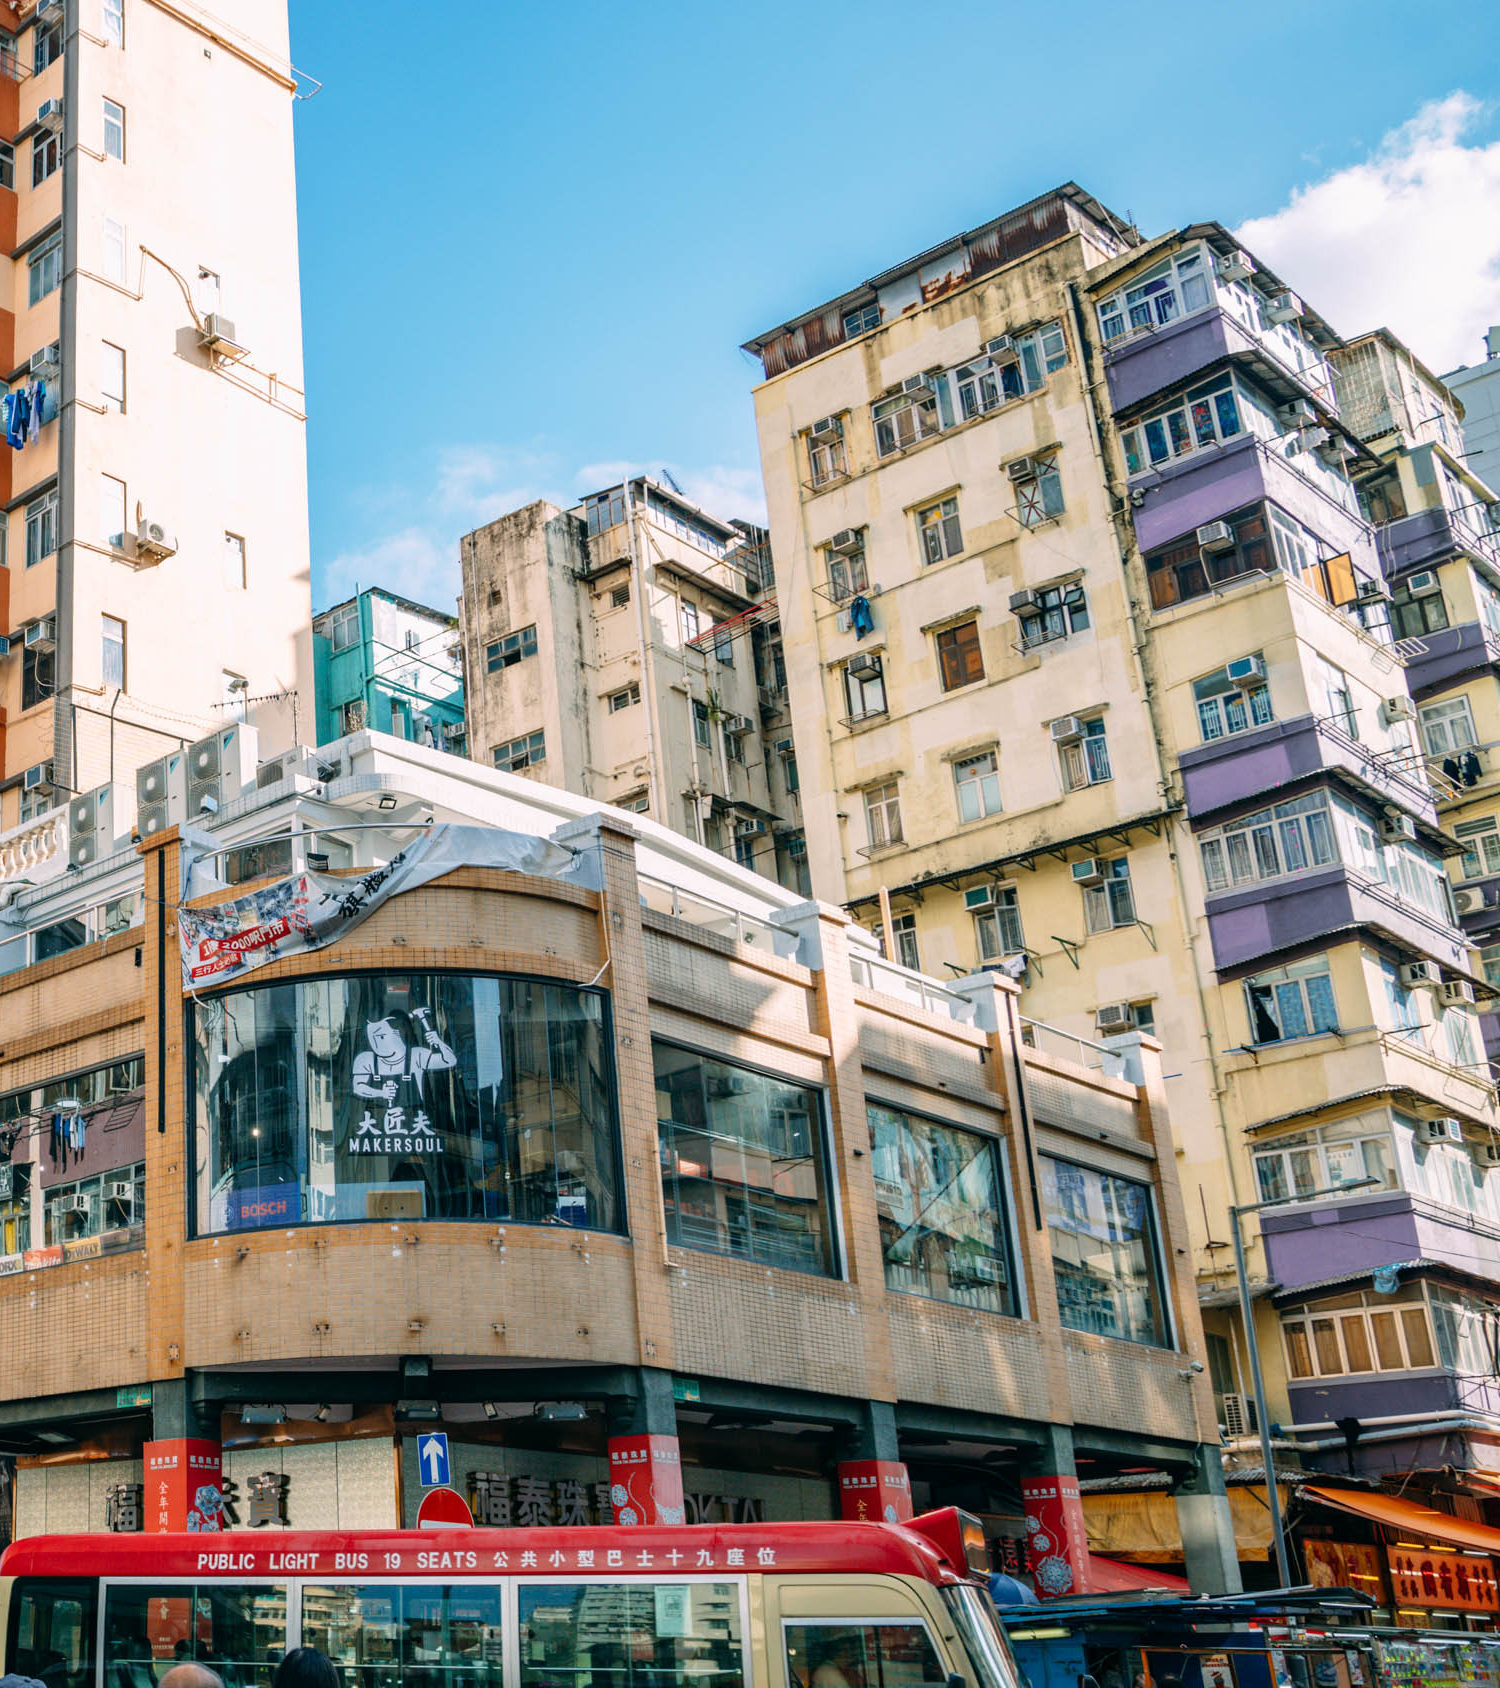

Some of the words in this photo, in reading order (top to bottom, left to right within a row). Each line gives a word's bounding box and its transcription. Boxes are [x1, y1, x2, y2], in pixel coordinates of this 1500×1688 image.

[356, 1107, 436, 1135] 大匠夫
[349, 1137, 443, 1152] MAKERSOUL
[241, 1200, 287, 1218] BOSCH
[198, 1553, 255, 1570] PUBLIC
[269, 1552, 319, 1570] LIGHT
[335, 1552, 369, 1569] BUS
[383, 1552, 401, 1569] 19
[416, 1551, 477, 1568] SEATS
[493, 1547, 777, 1568] 公共小型巴士十九座位
